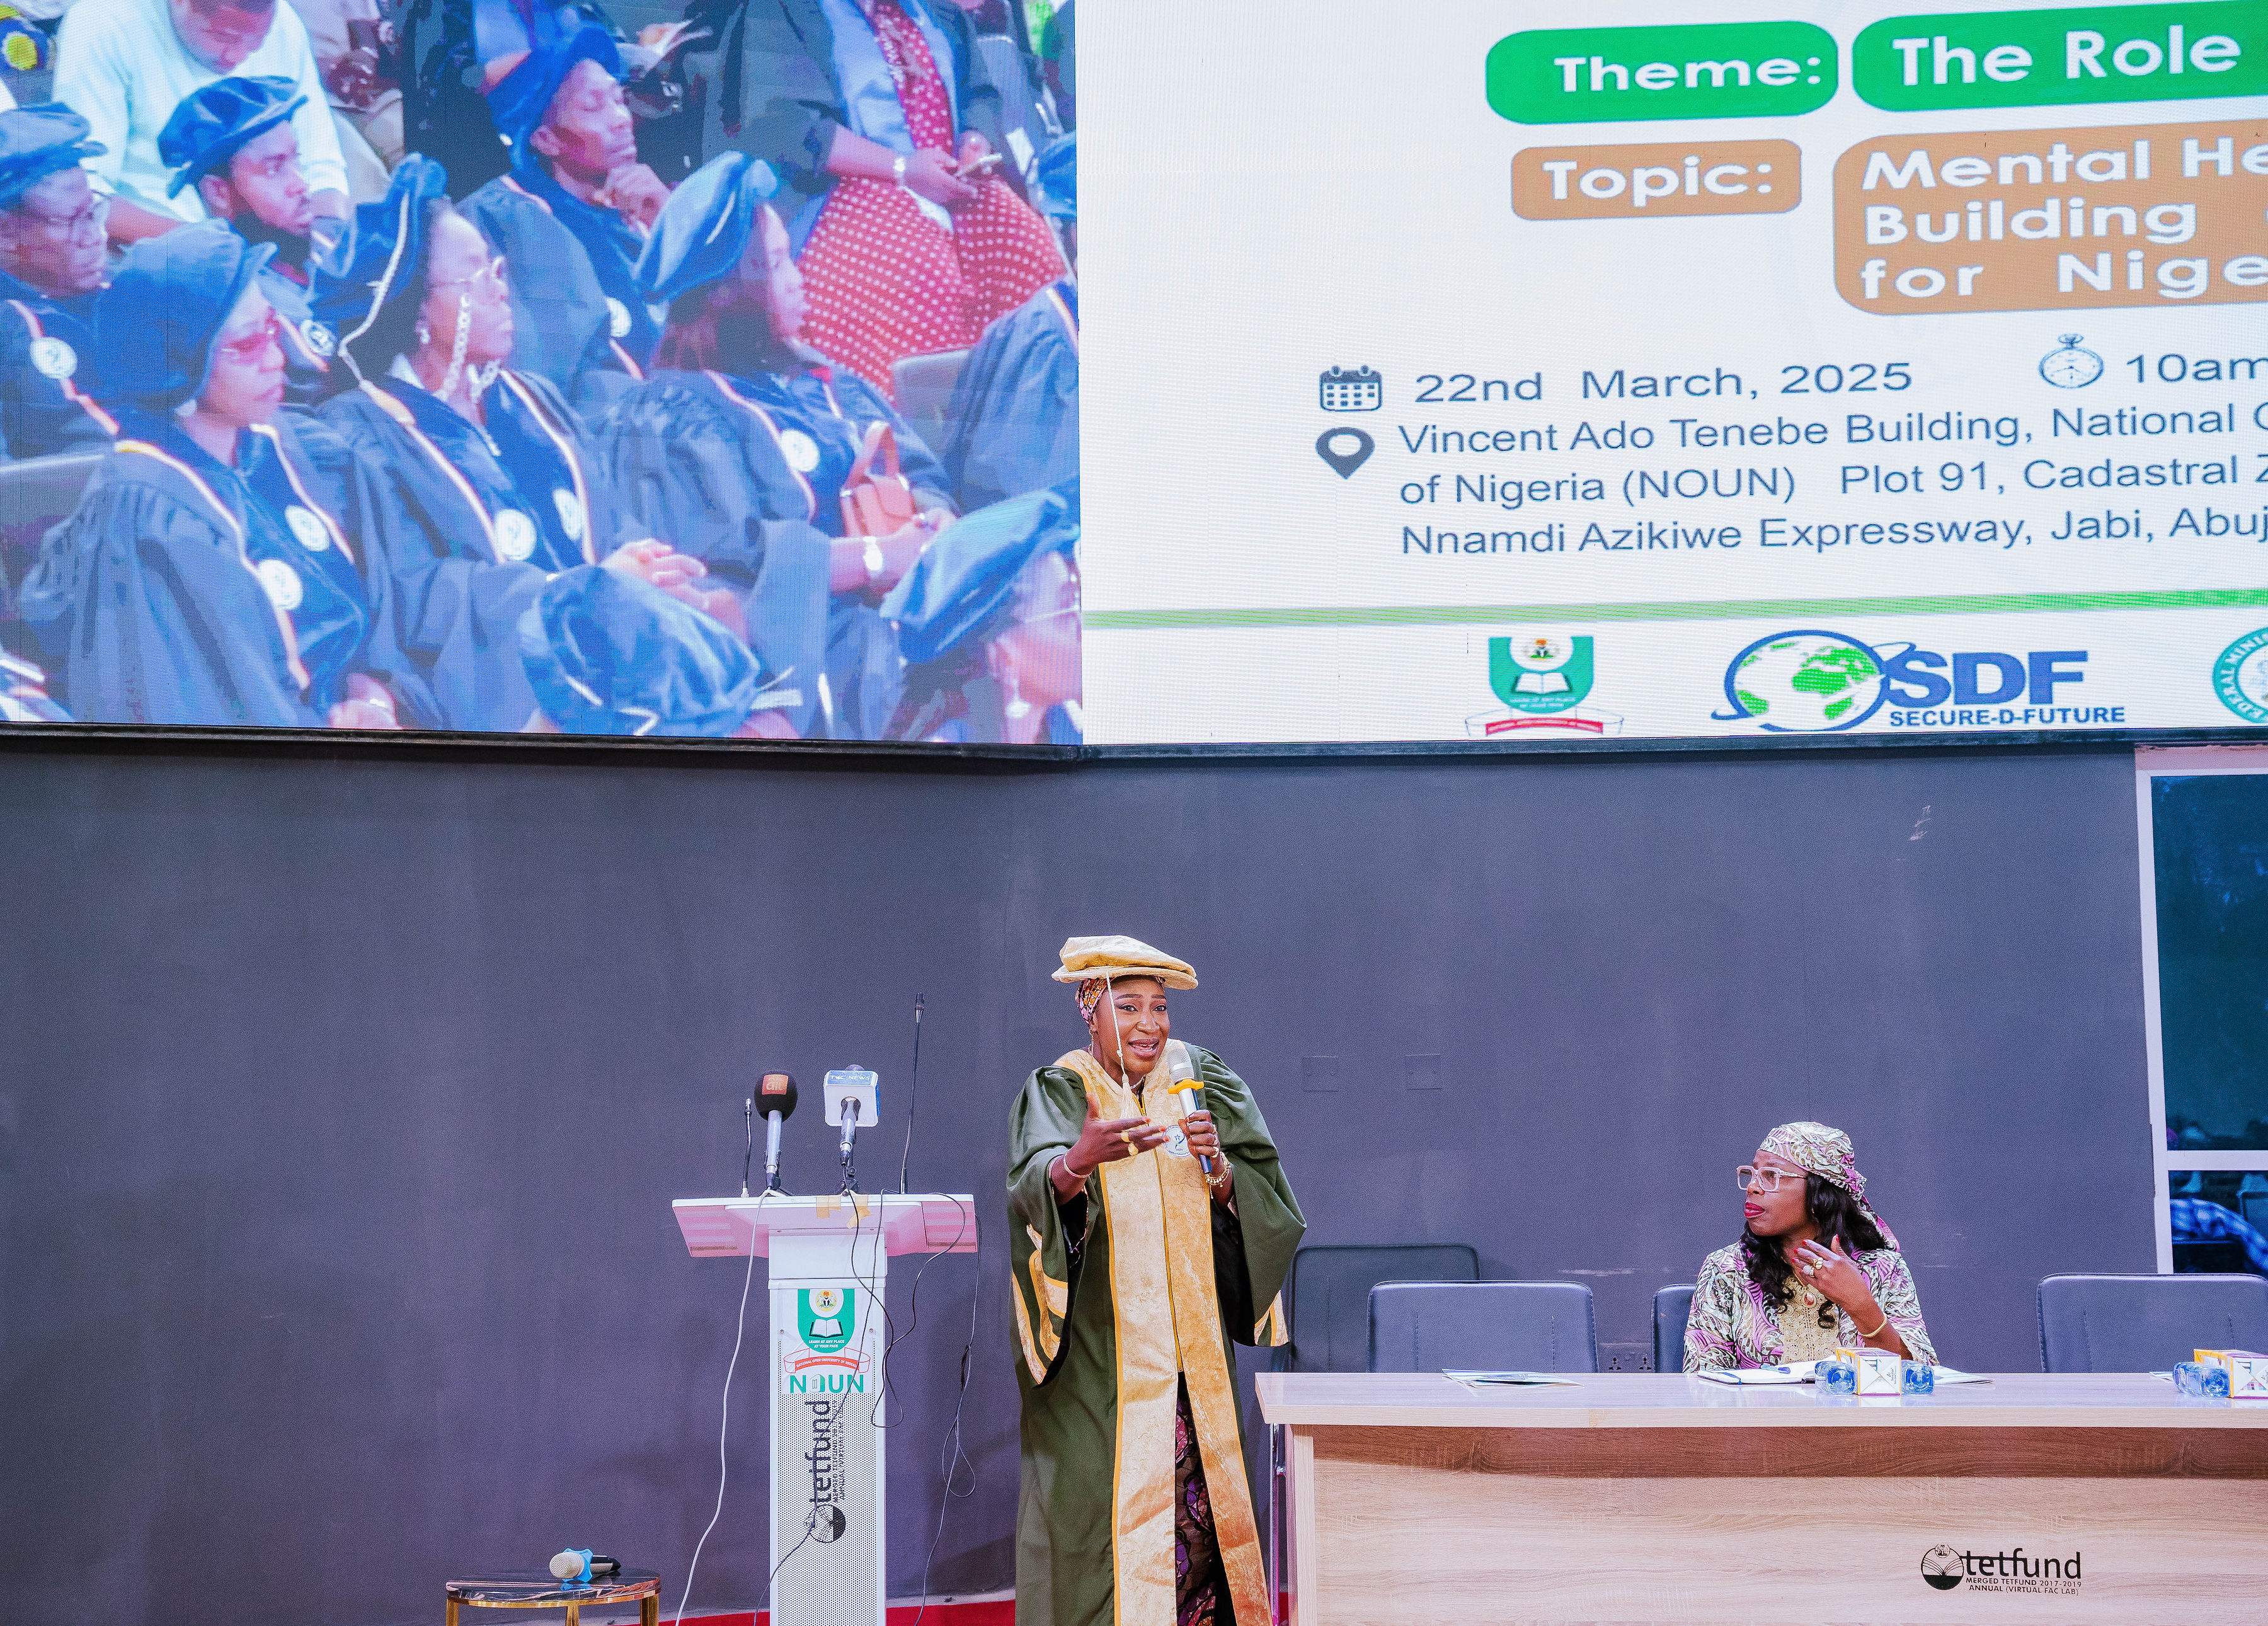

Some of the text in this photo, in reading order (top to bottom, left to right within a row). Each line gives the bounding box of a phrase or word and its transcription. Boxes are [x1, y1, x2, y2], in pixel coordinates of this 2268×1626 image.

[1554, 55, 1821, 92] Theme:
[1893, 24, 2242, 86] The Role
[1542, 154, 1772, 207] Topic:
[1862, 139, 2150, 190] Mental
[1864, 197, 2197, 245] Building
[1860, 249, 2268, 299] for Nige
[1415, 362, 1913, 402] 22nd March, 2025
[2126, 353, 2268, 382] 10am
[1398, 423, 1559, 454] Vincent
[1569, 420, 1655, 451] Ado
[1669, 416, 1828, 447] Tenebe
[1846, 411, 2033, 446] Building,
[2053, 403, 2235, 437] National
[1399, 474, 1441, 504] of
[1455, 472, 1605, 509] Nigeria
[1622, 466, 1796, 507] (NOUN)
[1841, 463, 1924, 494] Plot
[1939, 460, 2005, 495] 91,
[2023, 454, 2237, 489] Cadastral
[1402, 505, 2268, 554] Nnamdi Azikiwe Expressway, Jabi, Abuj
[1889, 650, 2089, 708] SDF
[1890, 706, 2125, 727] SECURE-D-FUTURE
[804, 1400, 832, 1503] tetfund
[1964, 1547, 2082, 1579] tetfund
[2061, 1588, 2079, 1596] LAB)
